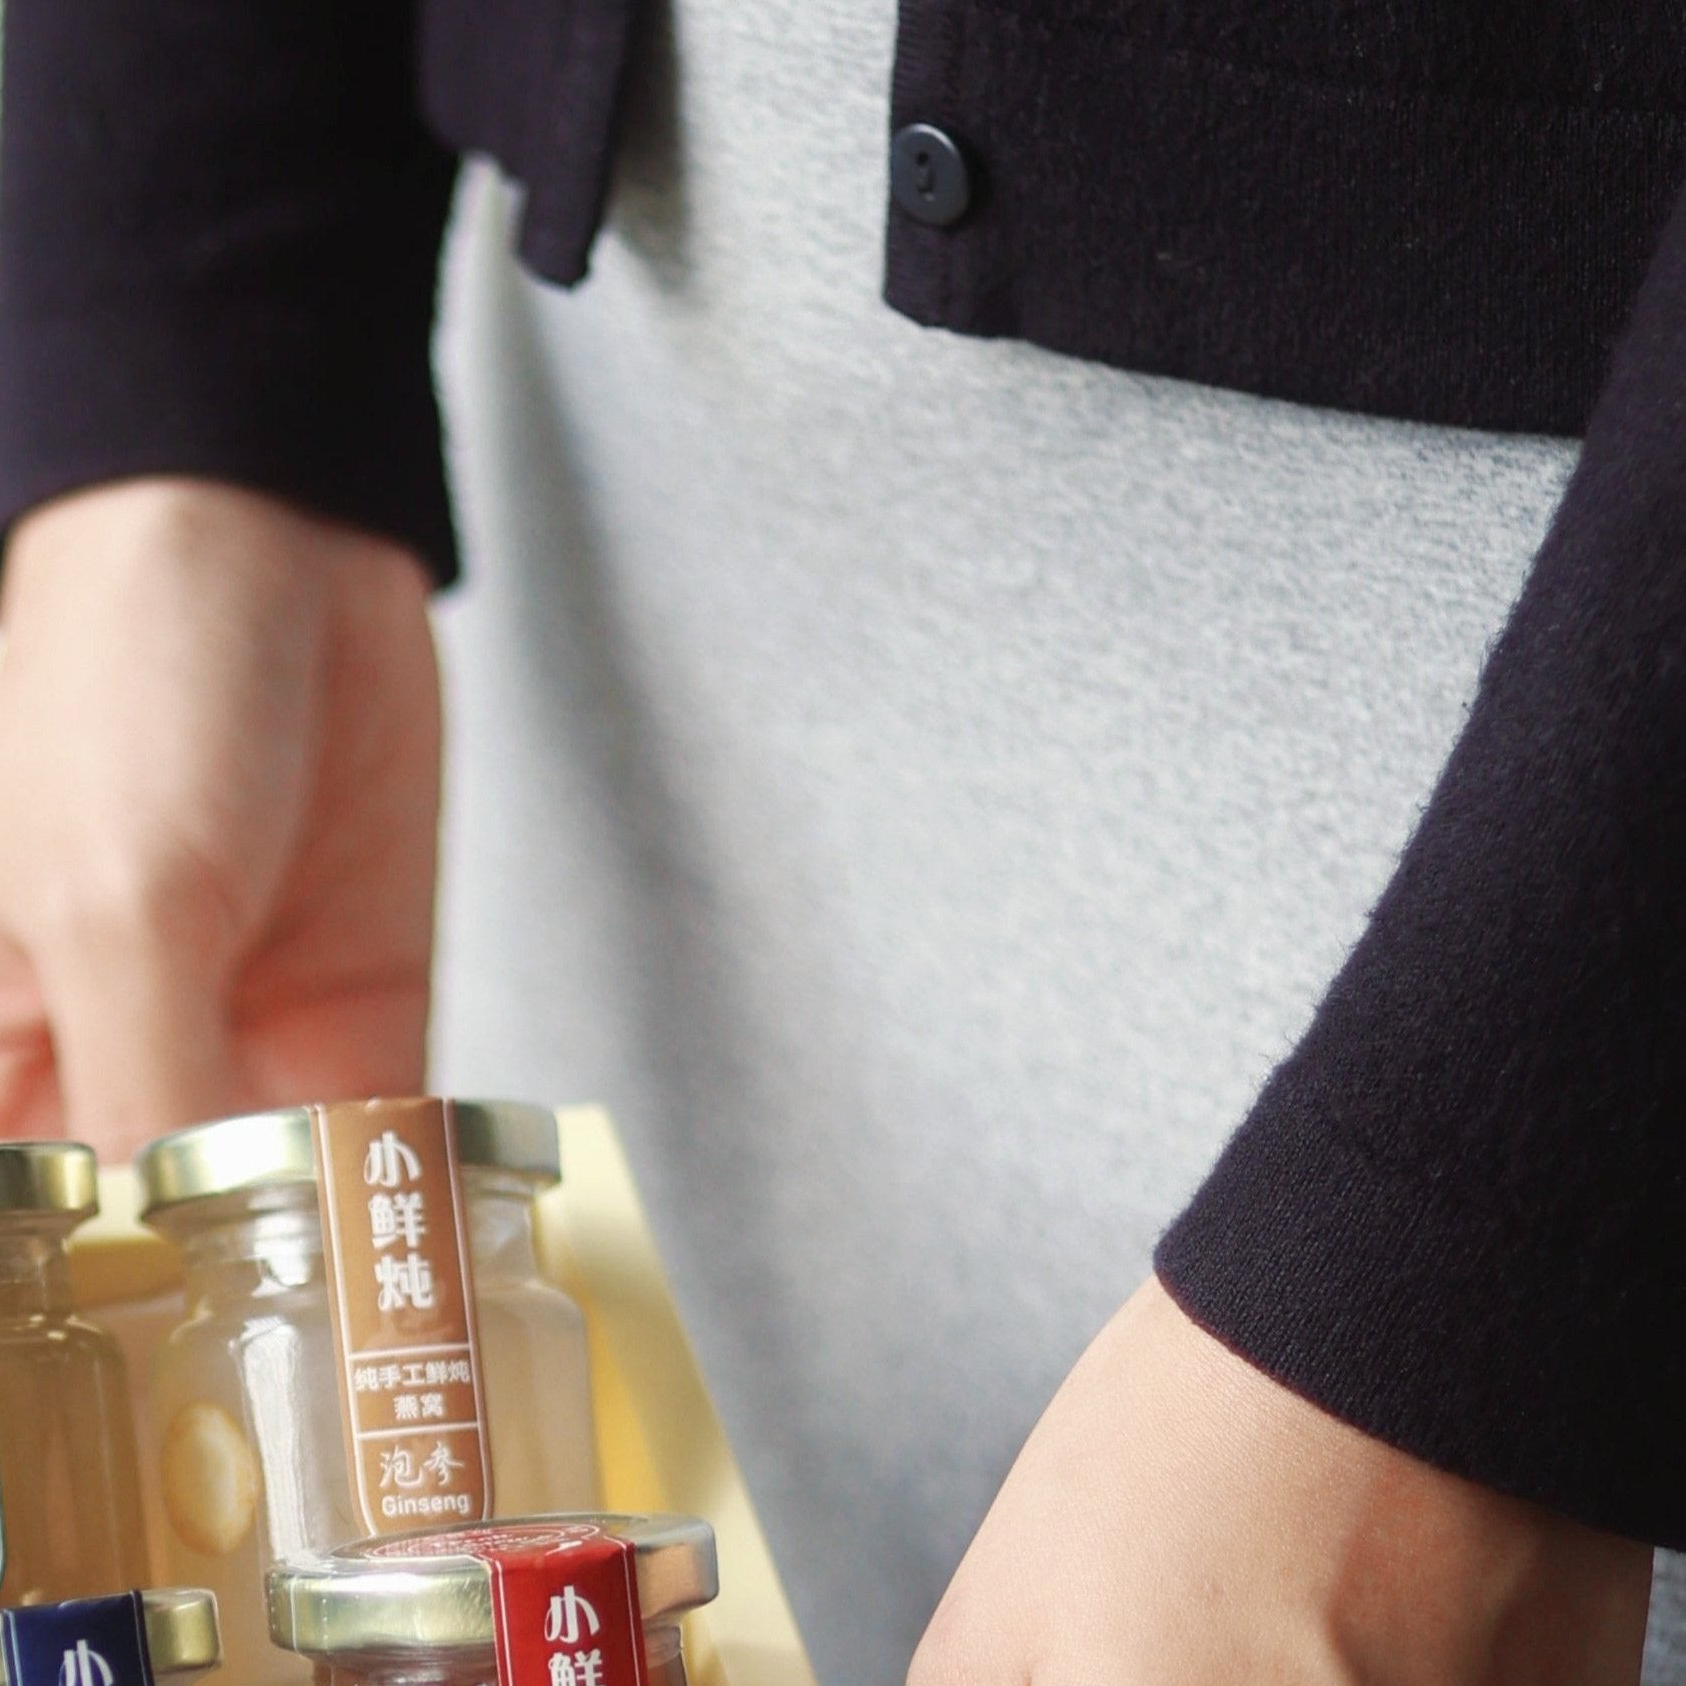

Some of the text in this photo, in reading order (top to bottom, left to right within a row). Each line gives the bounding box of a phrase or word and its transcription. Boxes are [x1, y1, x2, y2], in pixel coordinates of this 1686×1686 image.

[364, 1131, 434, 1311] 小鲜炖
[354, 1360, 471, 1392] 纯手工鲜炖
[394, 1393, 444, 1420] 燕窝
[381, 1492, 470, 1516] Ginseng
